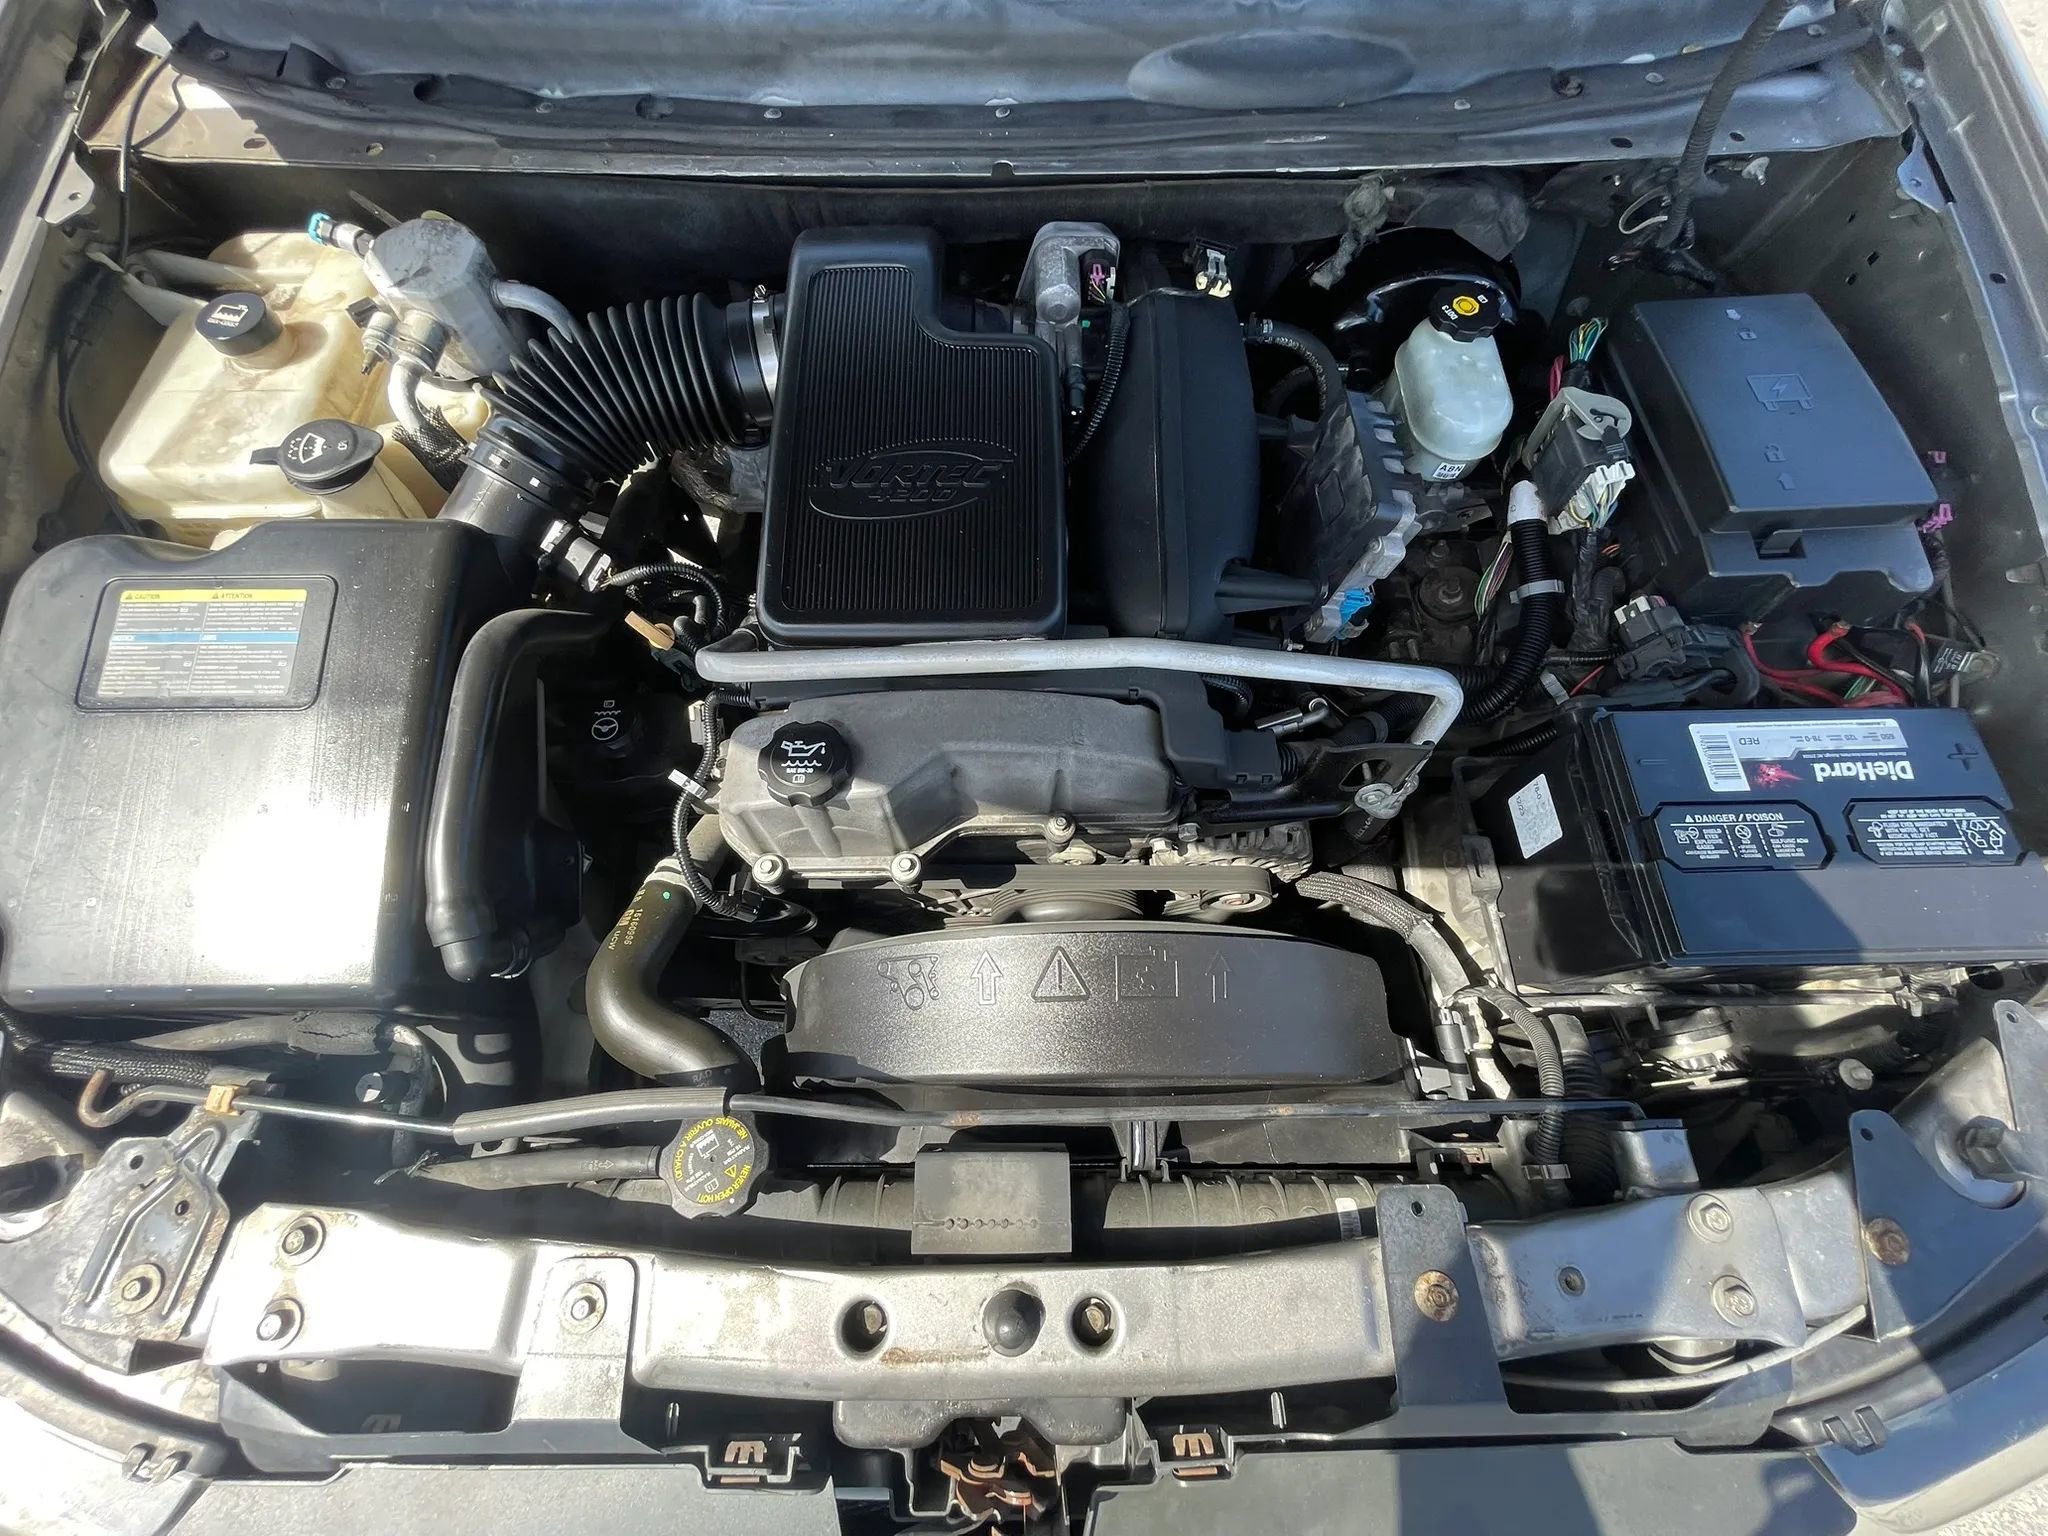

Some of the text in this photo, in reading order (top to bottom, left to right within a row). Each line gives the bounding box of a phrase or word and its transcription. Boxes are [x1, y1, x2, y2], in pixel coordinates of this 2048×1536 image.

[828, 464, 1002, 488] VORTEC
[220, 592, 253, 600] ATTENTION
[1739, 736, 1760, 745] RED
[1815, 760, 1915, 783] DieHard
[1695, 813, 1737, 823] DANGER
[1746, 812, 1784, 822] POISON
[685, 1118, 714, 1141] OUVRIR
[736, 1127, 749, 1141] NE
[697, 1164, 752, 1203] NEVER OPEN HOT!
